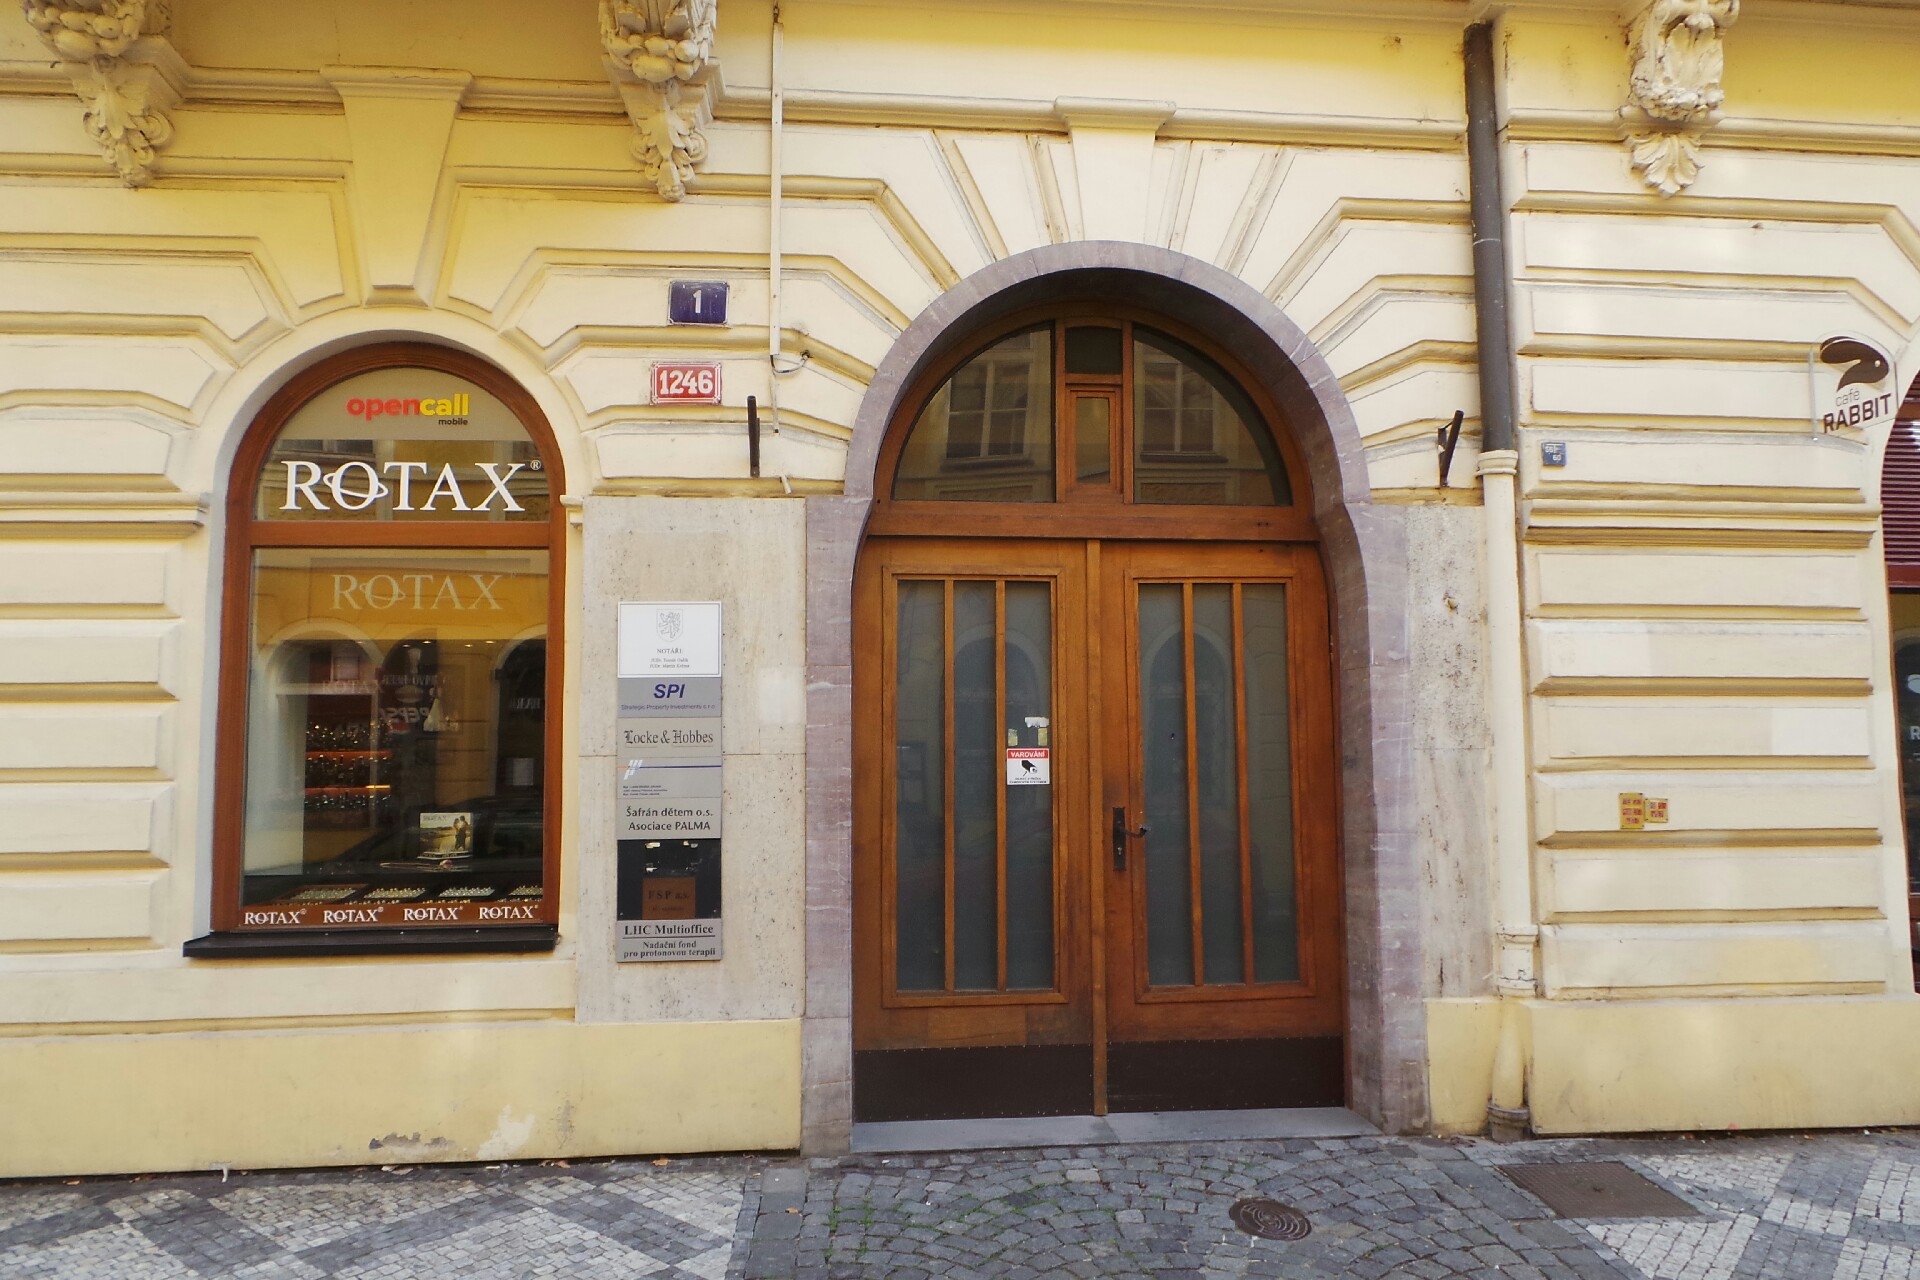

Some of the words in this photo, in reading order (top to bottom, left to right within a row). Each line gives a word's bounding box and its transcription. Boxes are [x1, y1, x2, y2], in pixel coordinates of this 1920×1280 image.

[692, 289, 702, 314] 1
[659, 369, 714, 395] 1246
[345, 393, 470, 421] opencall
[1823, 393, 1892, 434] RABBIT
[437, 417, 469, 426] mobile
[653, 683, 686, 699] SPI
[624, 729, 659, 744] Locke
[660, 730, 670, 744] &
[672, 729, 714, 744] Hobbes
[1010, 750, 1046, 758] VAROVÁNÍ
[626, 805, 658, 817] Šafrán
[661, 807, 693, 817] dětem
[695, 808, 713, 817] o.s.
[628, 821, 672, 831] Asociace
[675, 821, 711, 831] PALMA
[624, 925, 651, 935] LHC
[654, 924, 714, 935] Multioffice
[643, 941, 676, 949] Nadační
[678, 940, 697, 948] fond
[623, 951, 638, 959] pro
[640, 949, 686, 958] protonovou
[688, 948, 716, 957] terapii
